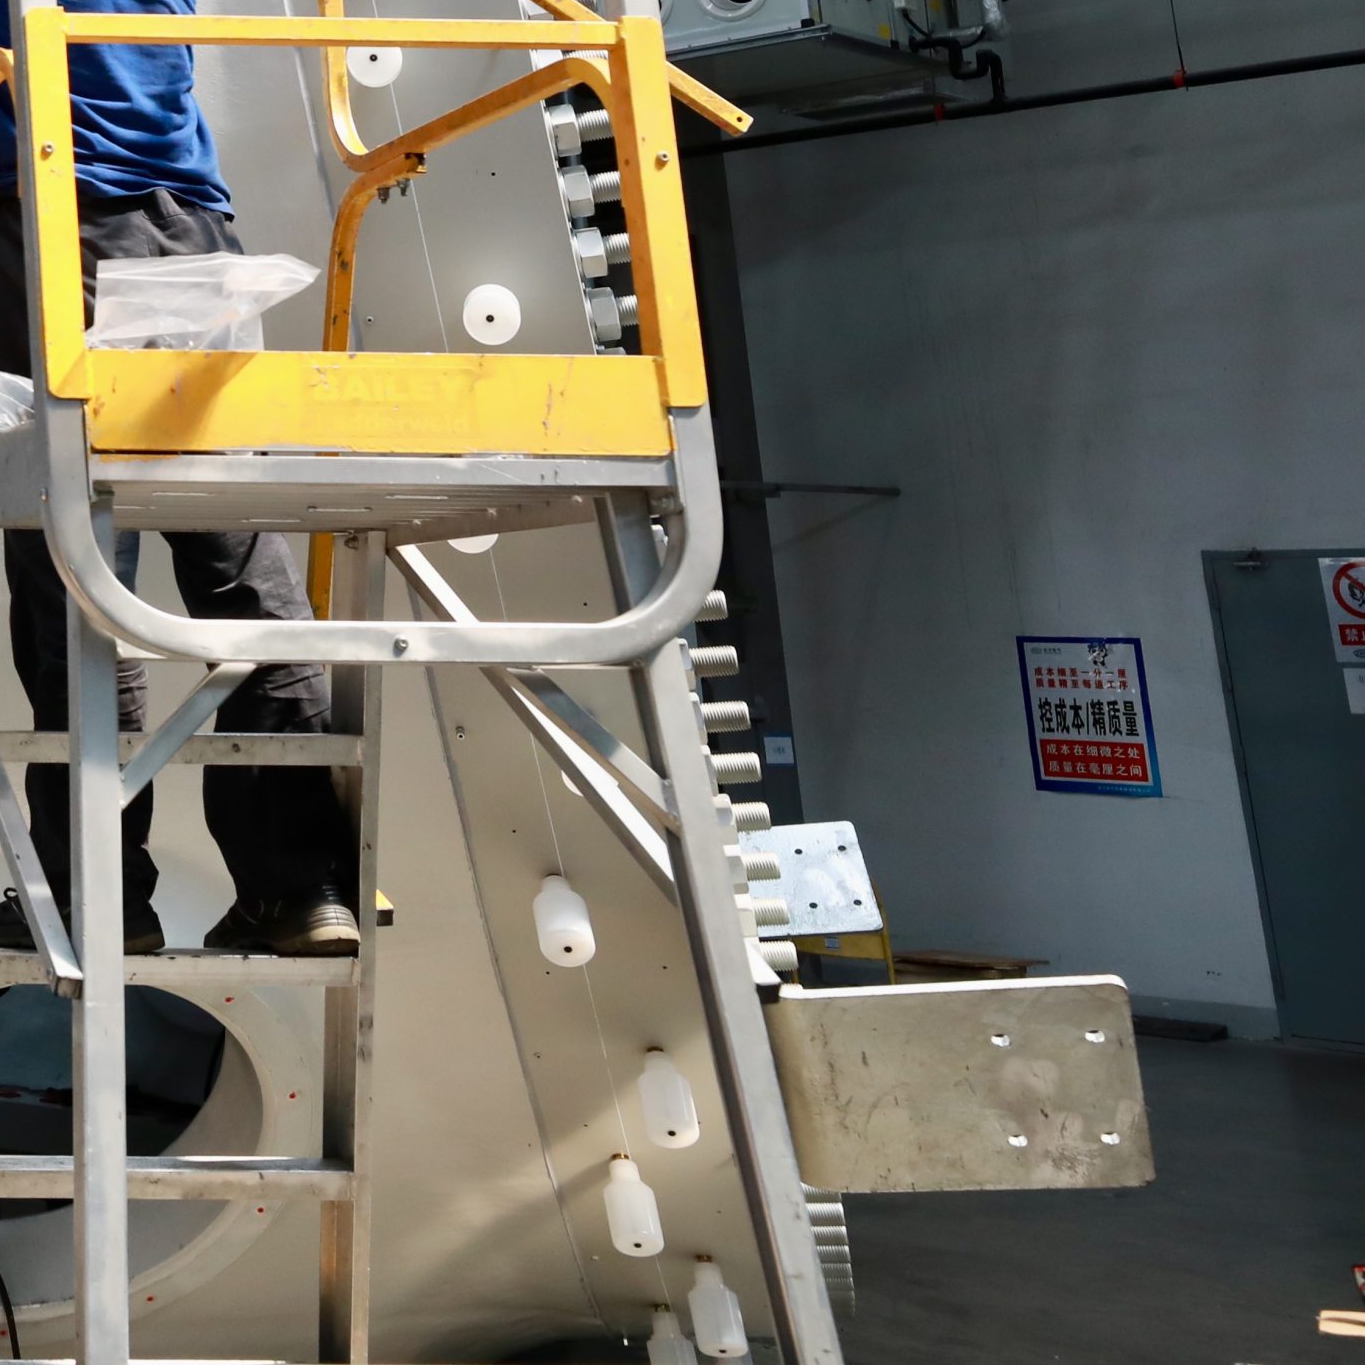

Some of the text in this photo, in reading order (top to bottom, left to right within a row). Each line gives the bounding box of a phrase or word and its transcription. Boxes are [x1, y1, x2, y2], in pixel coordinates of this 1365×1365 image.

[1046, 743, 1141, 760] 成本在细微之处
[1049, 761, 1143, 778] 质量在毫厘之间
